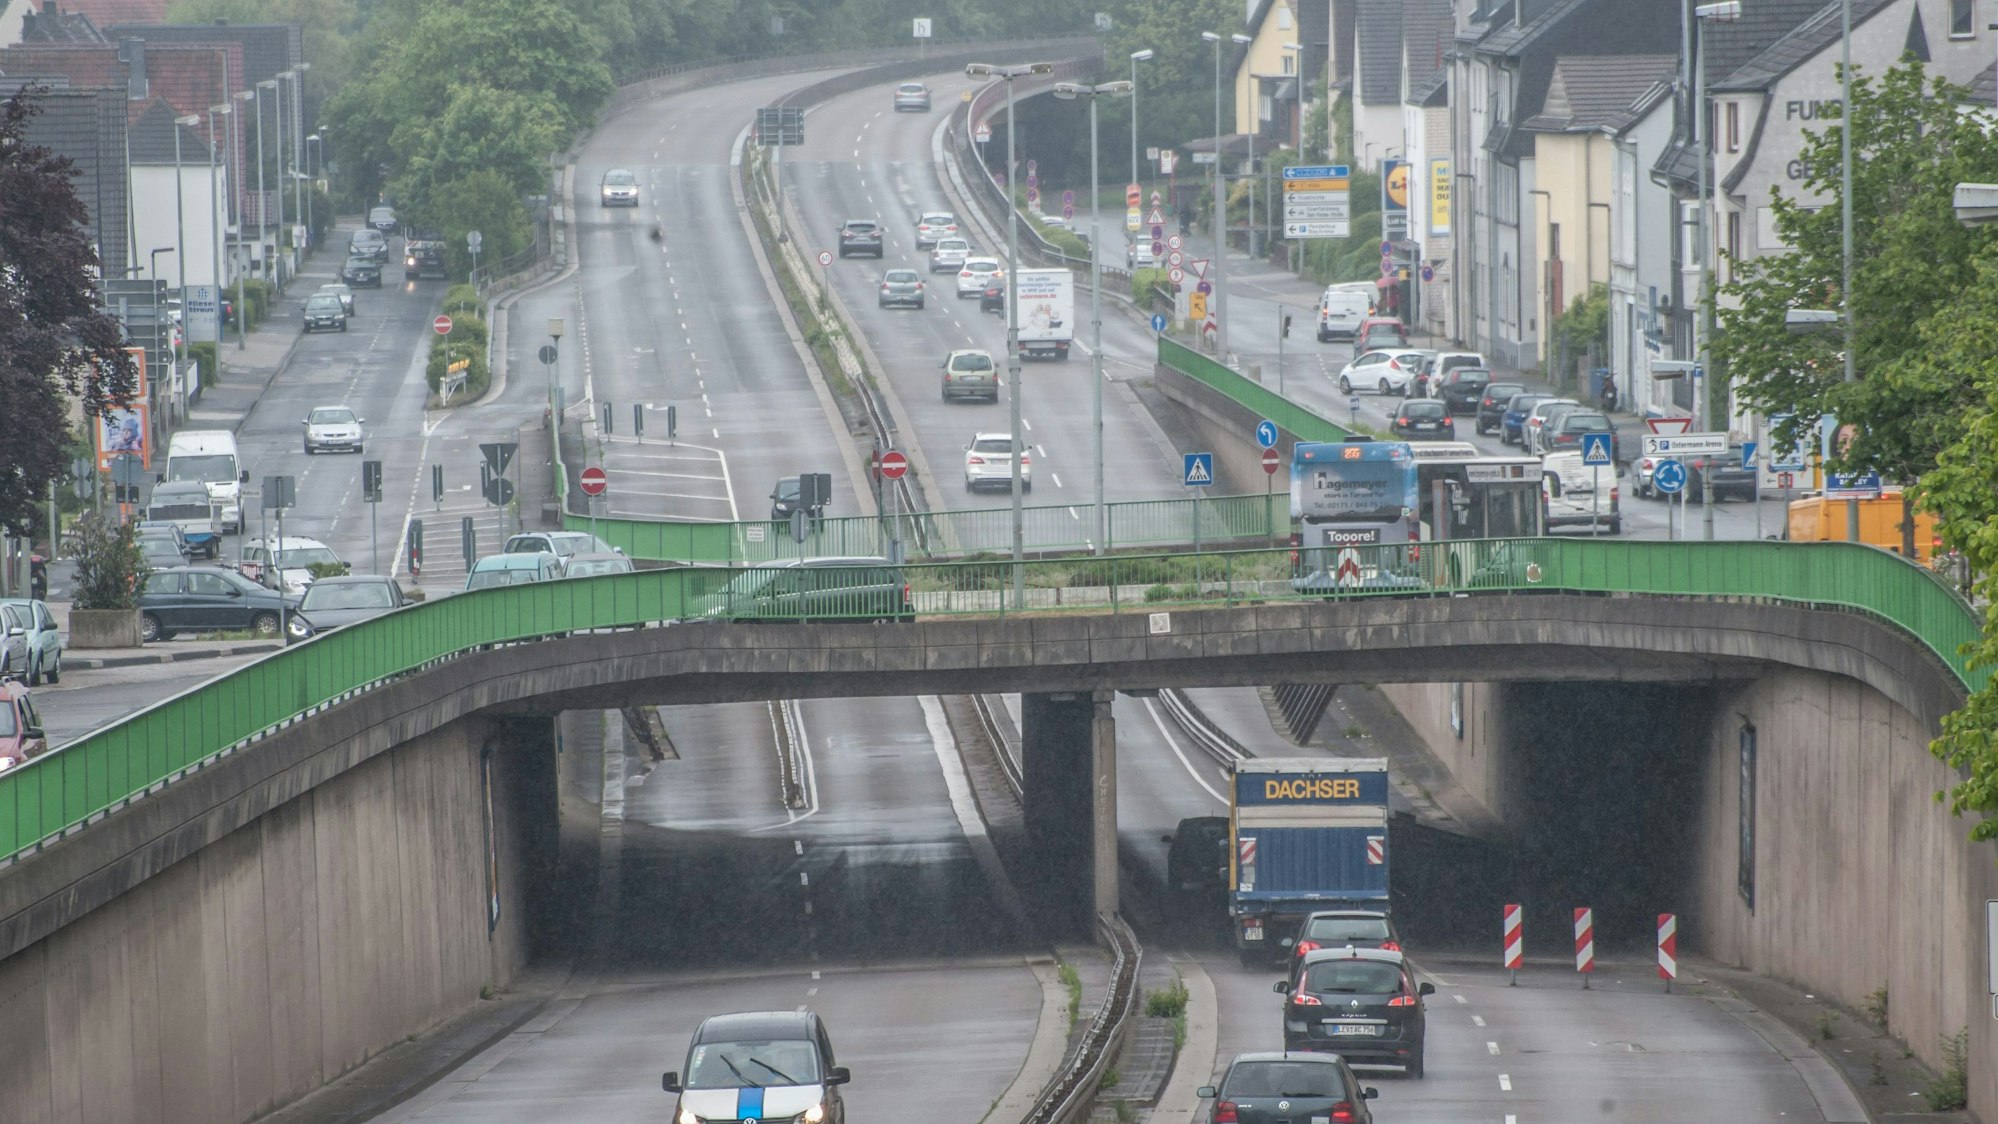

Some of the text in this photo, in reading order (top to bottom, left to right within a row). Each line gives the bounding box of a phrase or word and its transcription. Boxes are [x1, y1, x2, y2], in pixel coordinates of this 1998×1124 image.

[1671, 441, 1704, 449] Ostermann
[1705, 440, 1722, 448] Arena
[1313, 471, 1388, 491] hagemeyer
[1327, 530, 1375, 542] Tooore!
[1265, 779, 1360, 799] DACHSER
